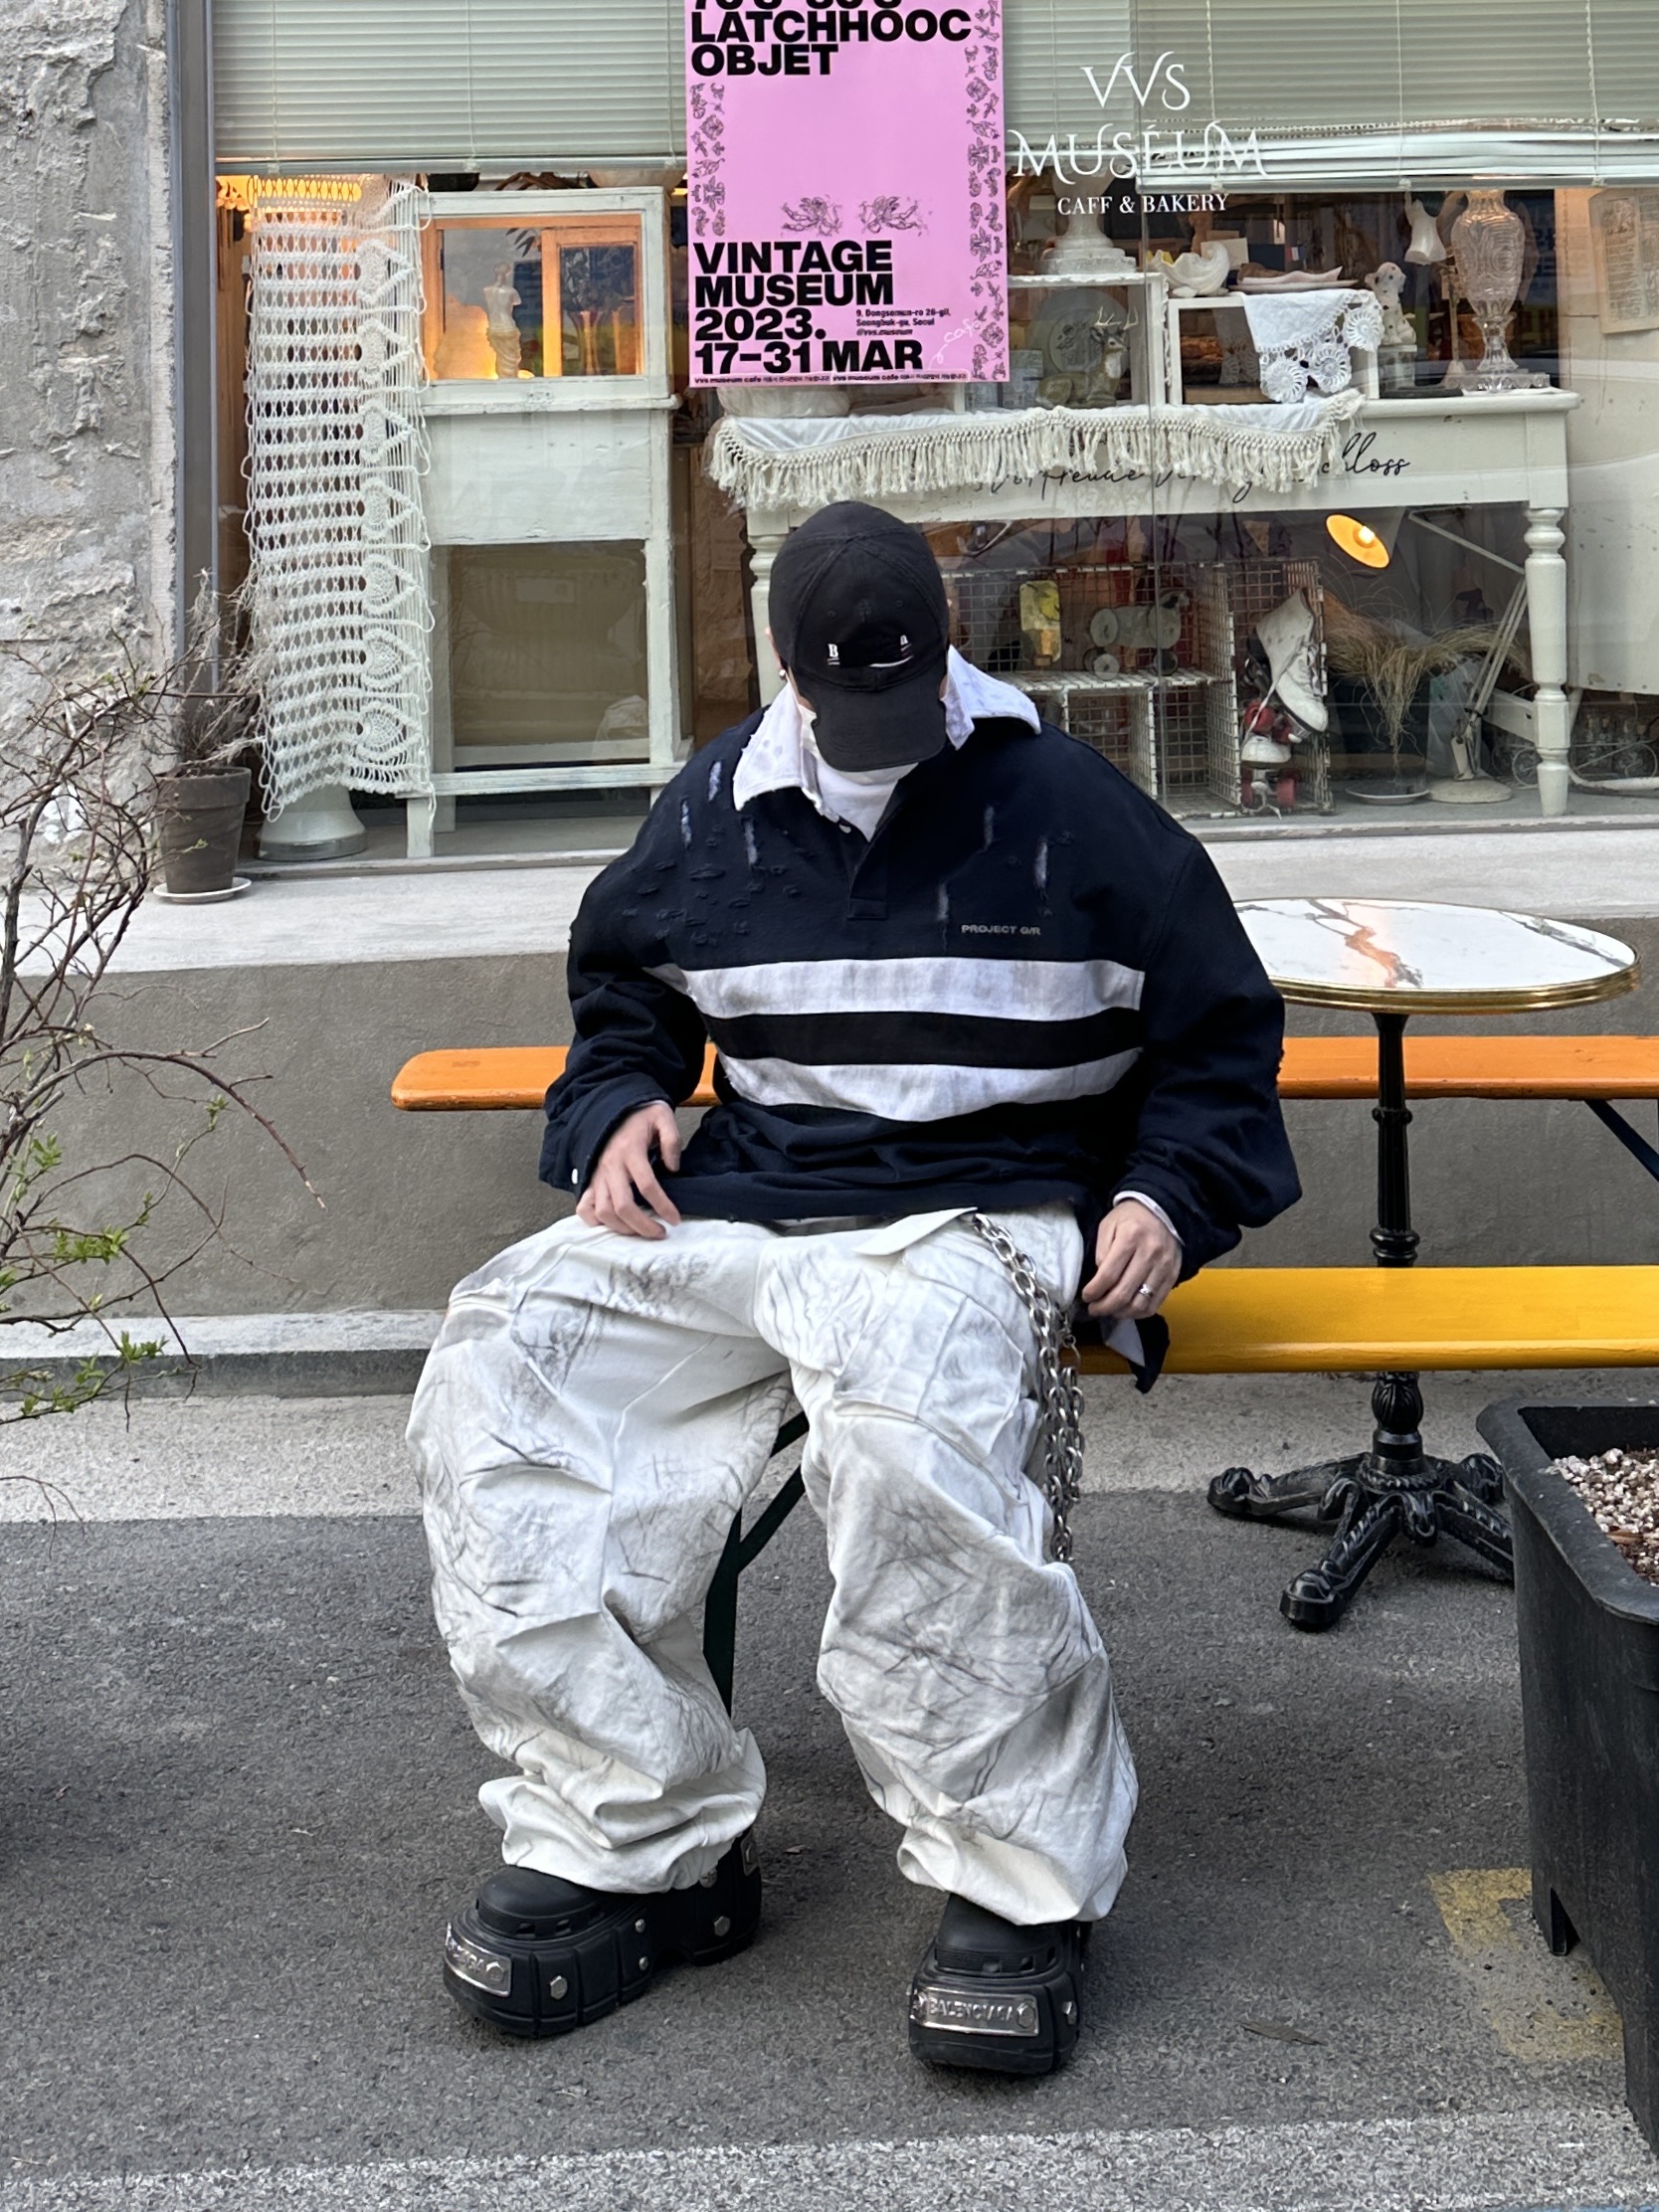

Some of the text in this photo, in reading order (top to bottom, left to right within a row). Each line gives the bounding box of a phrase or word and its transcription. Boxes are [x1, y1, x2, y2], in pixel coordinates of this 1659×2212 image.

[691, 9, 972, 43] LATCHHOOC
[691, 44, 838, 77] OBJET
[1080, 51, 1191, 110] VVS
[1119, 196, 1136, 214] &
[1143, 193, 1229, 214] BAKERY
[693, 240, 892, 274] VINTAGE
[695, 274, 893, 307] MUSEUM
[695, 307, 827, 341] 2023.
[695, 339, 923, 374] 17-31 MAR
[961, 924, 1016, 934] PROJECT
